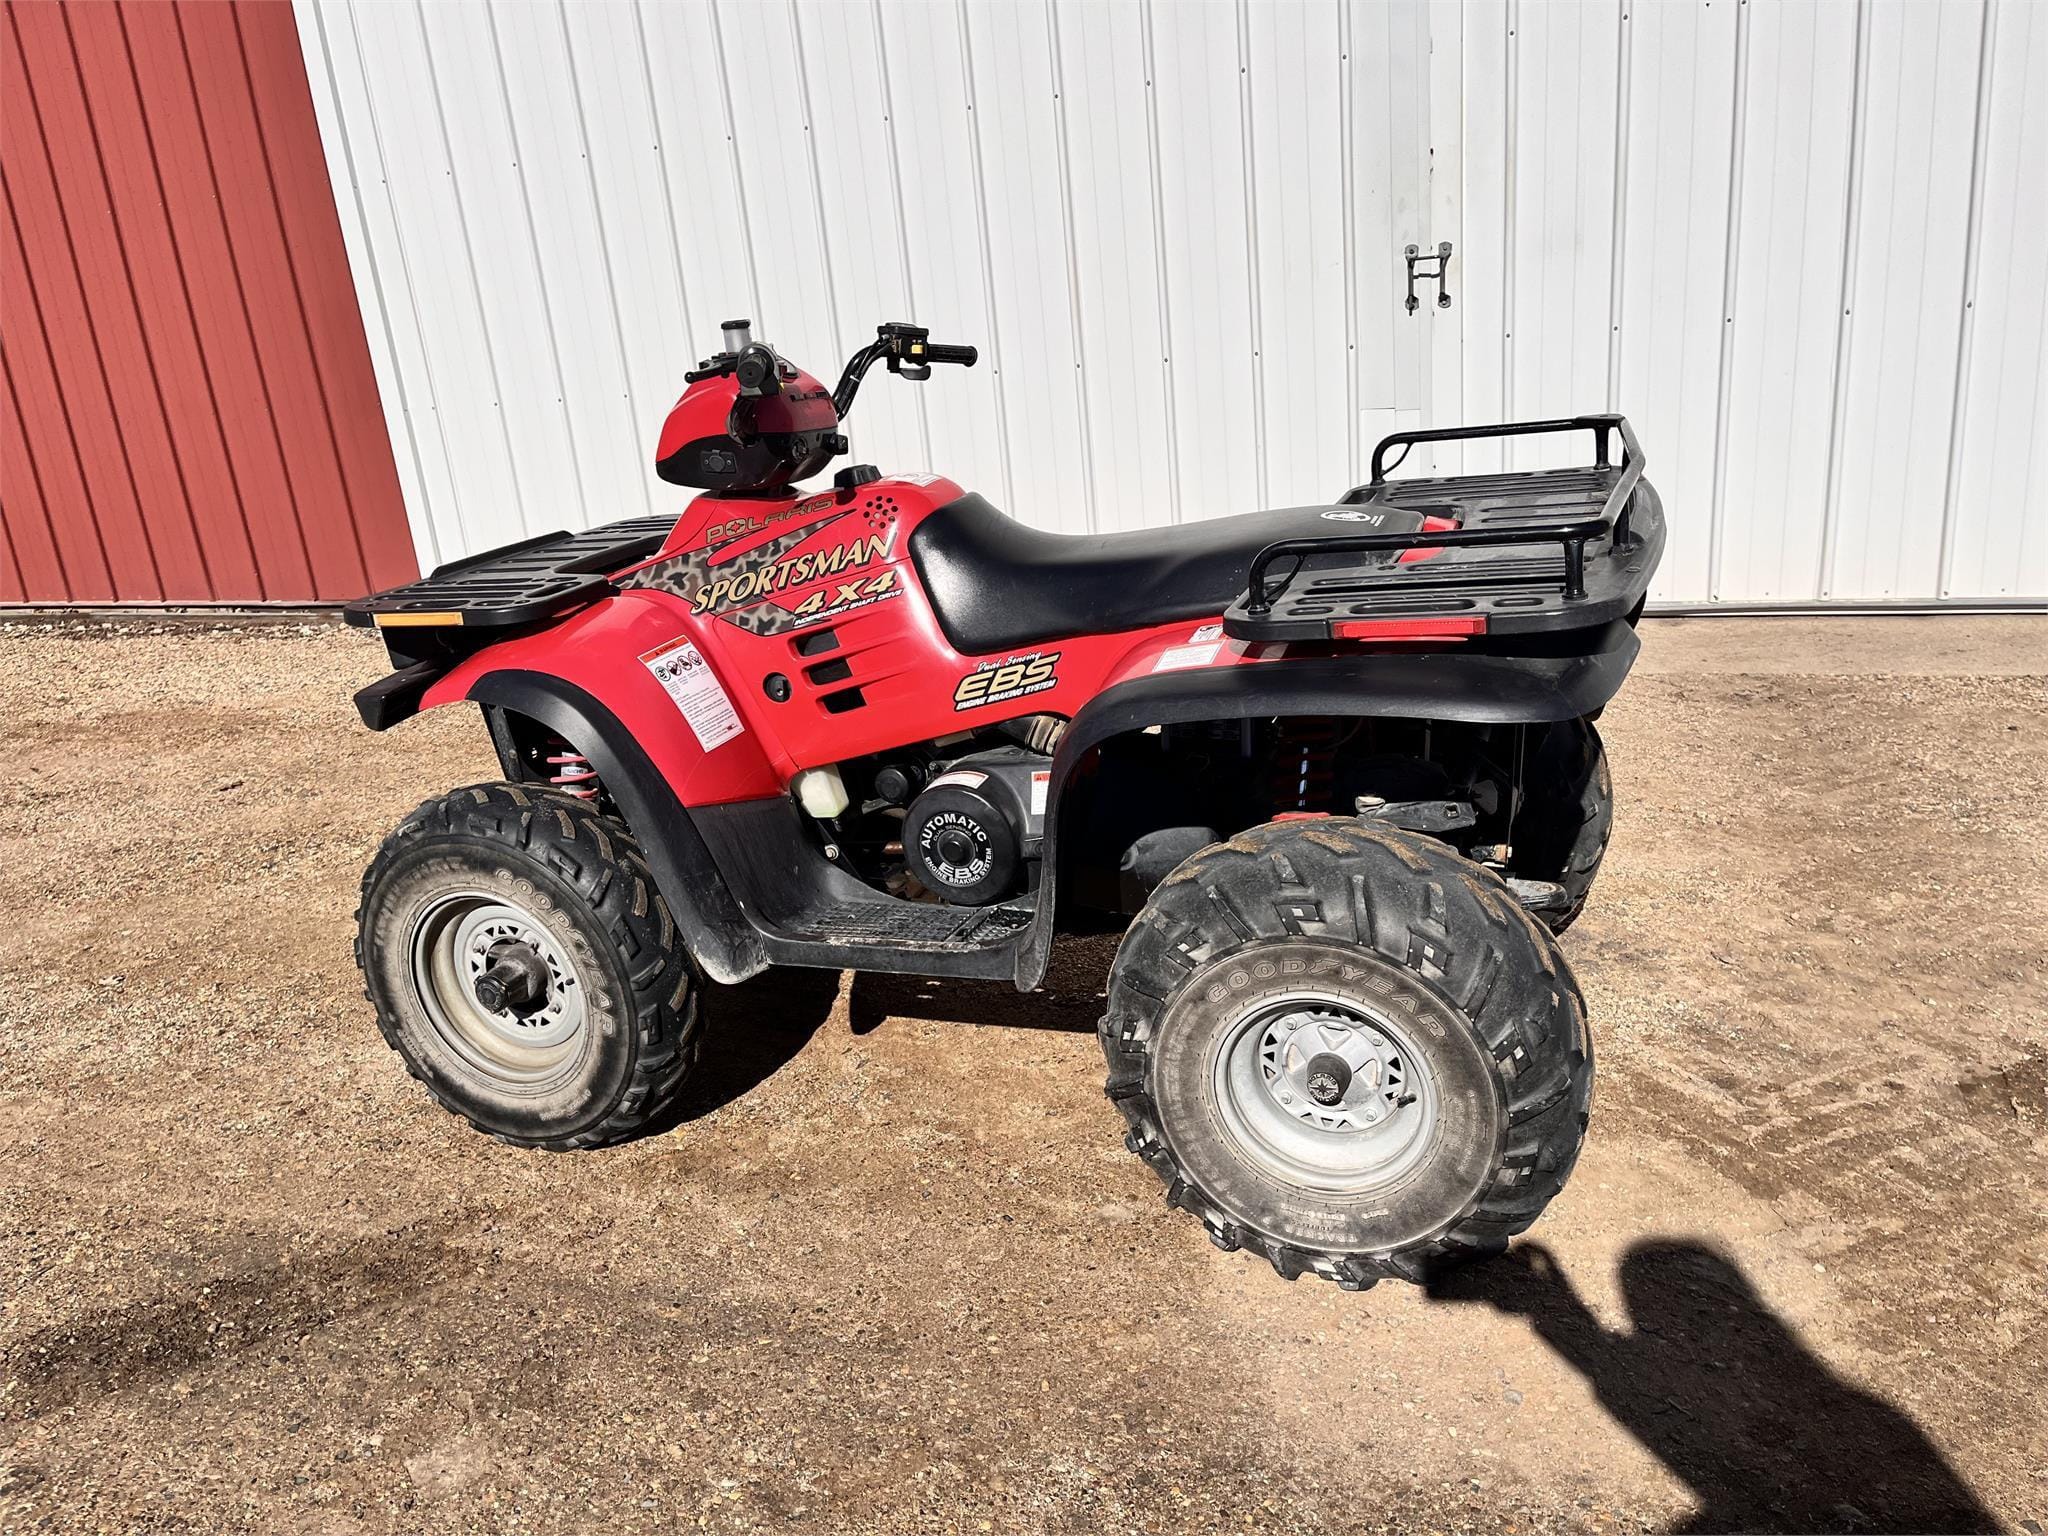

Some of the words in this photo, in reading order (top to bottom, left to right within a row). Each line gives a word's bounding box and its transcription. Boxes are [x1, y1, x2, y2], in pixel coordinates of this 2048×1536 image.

[706, 496, 835, 544] POLARIS
[690, 526, 898, 615] SPORTSMAN
[794, 570, 896, 615] 4X4
[954, 653, 1060, 702] EBS
[977, 659, 1002, 672] Dual
[1005, 652, 1042, 666] Sensing
[956, 696, 988, 710] ENGINE
[987, 687, 1025, 704] BRAKING
[1024, 679, 1056, 694] SYSTEM
[921, 813, 987, 849] AUTOMATIC
[924, 856, 948, 881] ENGINE
[948, 874, 981, 885] BRAKING
[980, 847, 993, 876] SYSTEM
[938, 858, 984, 879] EBS
[1207, 958, 1448, 1039] GOODYEAR
